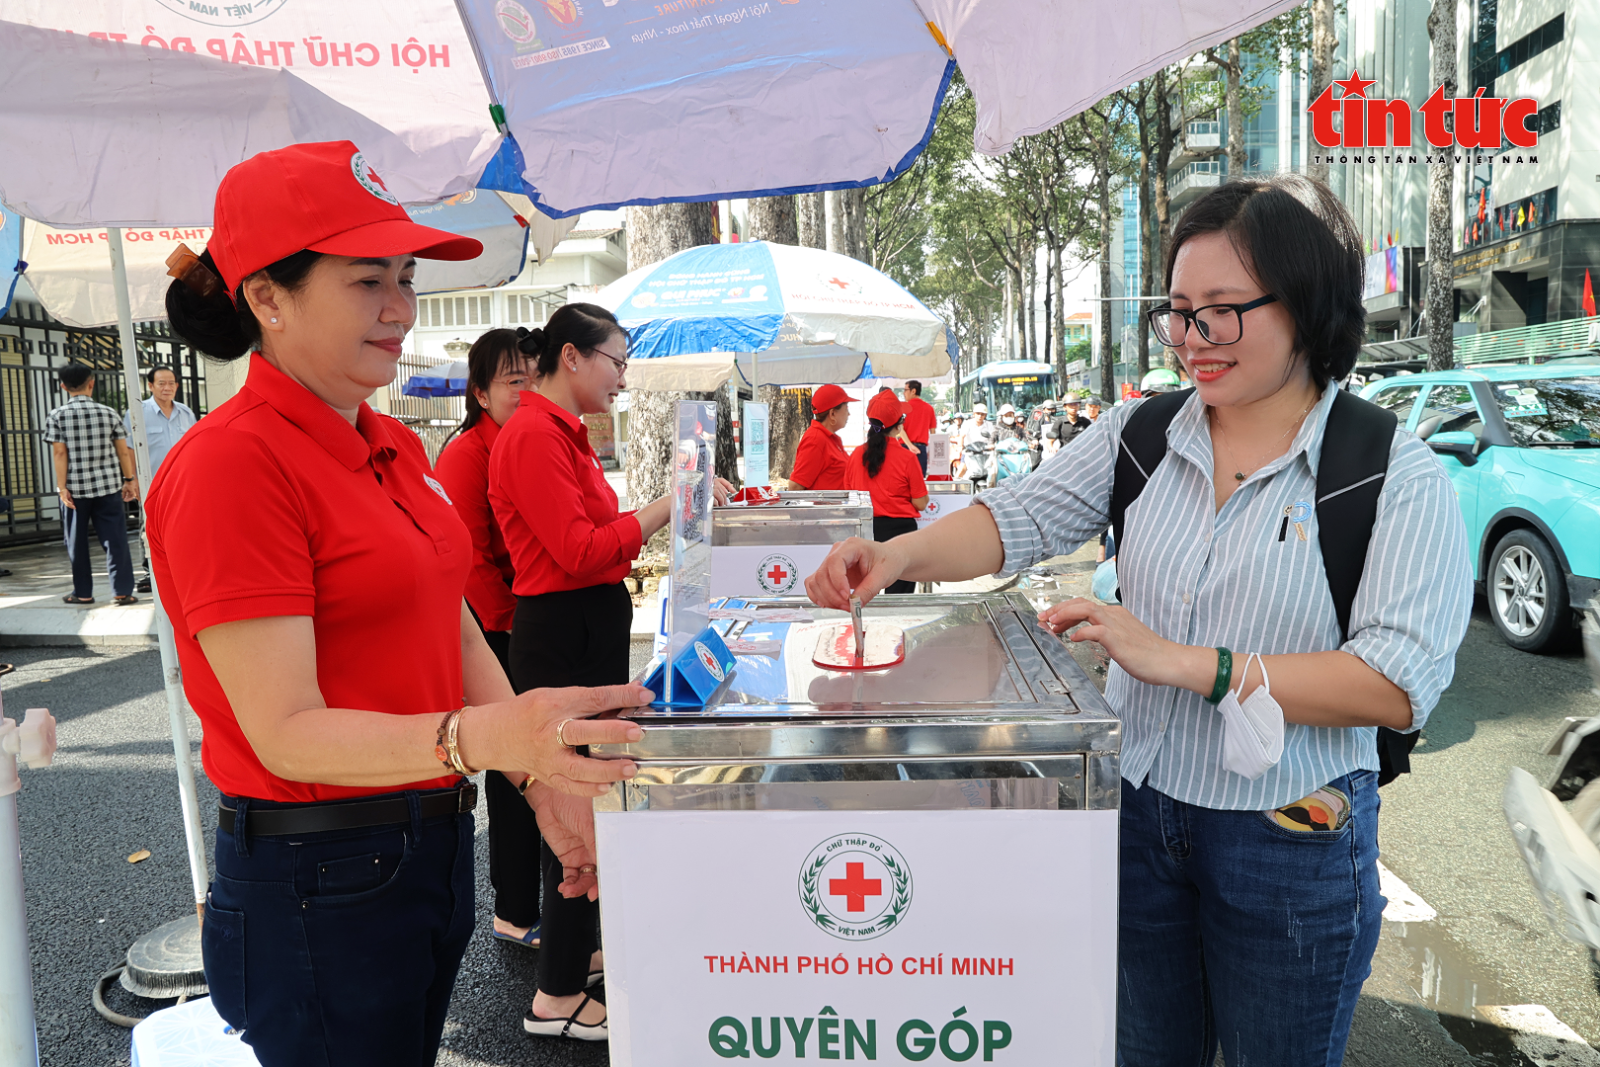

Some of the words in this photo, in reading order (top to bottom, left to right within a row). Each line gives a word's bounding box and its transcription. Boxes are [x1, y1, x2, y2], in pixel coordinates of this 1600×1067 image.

[826, 839, 843, 852] CHỮ
[845, 838, 867, 847] THẬP
[869, 842, 883, 852] ĐỎ
[838, 926, 856, 936] VIỆT
[857, 926, 876, 936] NAM
[703, 952, 789, 974] THÀNH
[797, 952, 850, 975] PHỐ
[857, 952, 893, 975] HỒ
[901, 952, 943, 975] CHÍ
[951, 957, 1014, 976] MINH
[708, 1005, 877, 1060] QUYÊN
[896, 1005, 1012, 1062] GÓP
